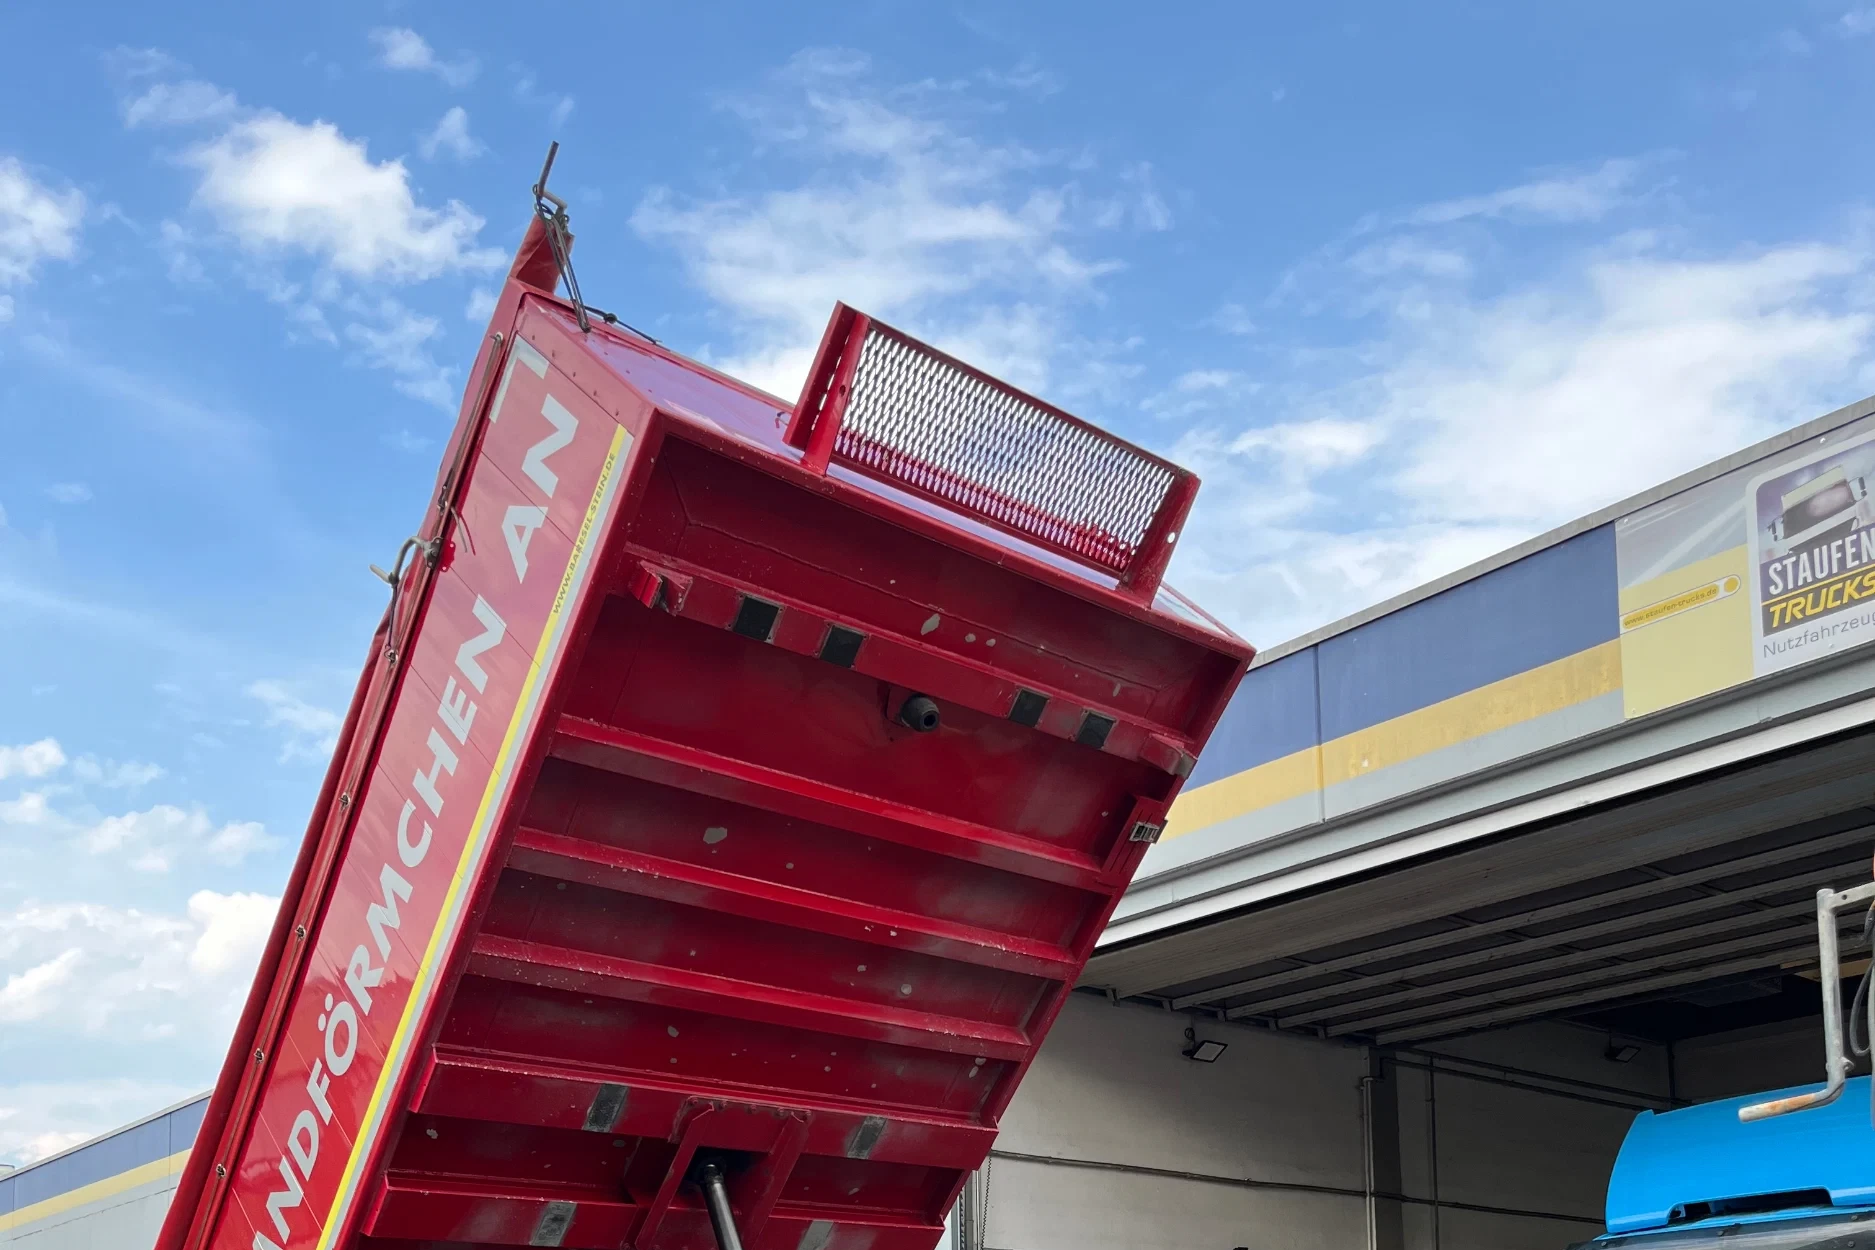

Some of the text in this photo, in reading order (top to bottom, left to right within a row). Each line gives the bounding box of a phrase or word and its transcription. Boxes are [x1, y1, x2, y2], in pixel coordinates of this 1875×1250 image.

[501, 393, 579, 585] AN
[552, 452, 617, 615] WWW.BARESEL-STEIN.DE
[1768, 527, 1875, 596] STAUFEN
[1623, 588, 1718, 627] www.staufen-trucks.de
[1769, 570, 1875, 628] TRUCKS
